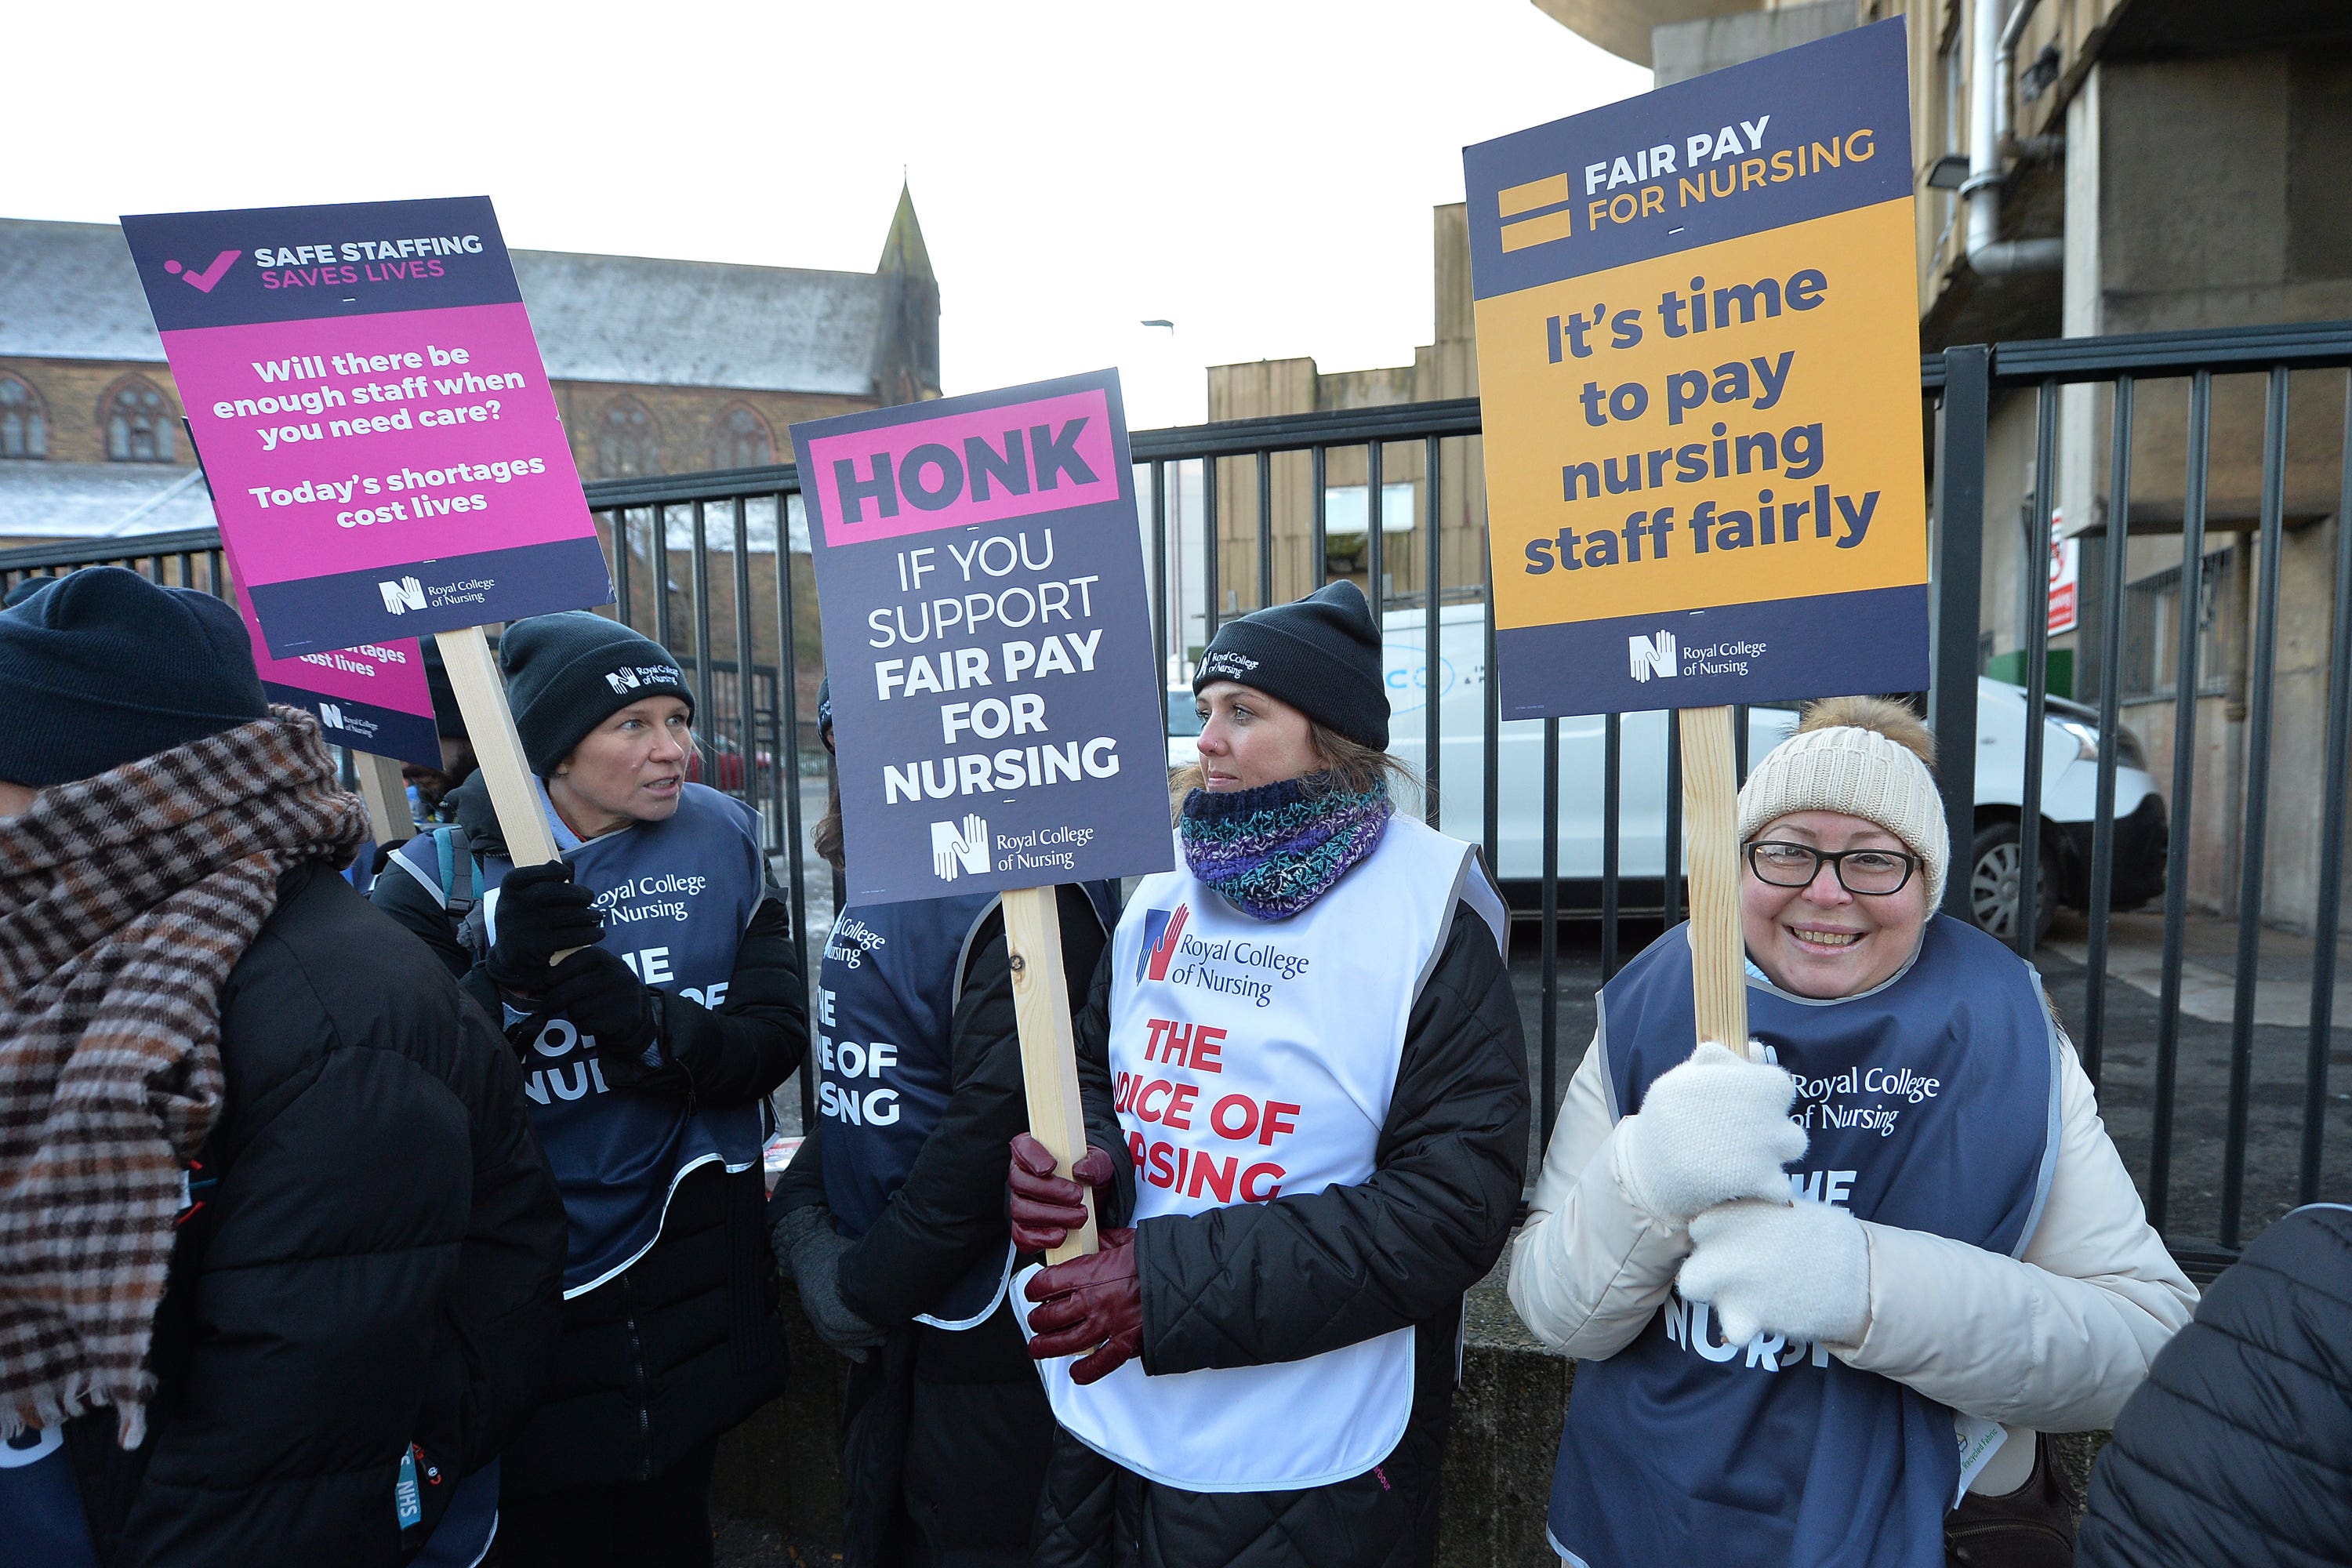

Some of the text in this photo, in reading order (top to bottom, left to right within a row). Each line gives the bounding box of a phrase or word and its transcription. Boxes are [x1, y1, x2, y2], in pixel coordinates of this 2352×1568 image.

[1584, 114, 1771, 196] FAIR PAY
[1588, 129, 1875, 231] FOR NURSING
[254, 234, 483, 268] SAFE STAFFING
[261, 259, 445, 289] SAVES LIVES
[1547, 267, 1828, 364] It's time
[252, 345, 470, 383] Will there be
[213, 368, 525, 422] enough staff when
[1580, 350, 1795, 427] to pay
[256, 400, 501, 452] you need care?
[833, 416, 1101, 524] HONK
[1562, 421, 1824, 502] nursing
[249, 454, 545, 509] Today's shortages
[336, 491, 488, 528] cost lives
[1525, 484, 1882, 575] staff fairly
[896, 528, 1054, 592] IF YOU
[428, 578, 495, 597] Royal College
[432, 592, 485, 607] of Nursing
[868, 575, 1099, 648] SUPPORT
[335, 654, 376, 677] lives
[874, 628, 1104, 701] FAIR PAY
[1213, 652, 1259, 670] Royal College
[1682, 639, 1767, 661] Royal College
[1682, 659, 1749, 677] of Nursing
[636, 665, 659, 676] Royal
[643, 676, 651, 685] of
[940, 695, 1049, 745] FOR
[883, 735, 1121, 806] NURSING
[996, 825, 1094, 853] Royal College
[997, 849, 1076, 871] of Nursing
[640, 874, 706, 896] College
[612, 900, 688, 922] Nursing
[841, 918, 886, 951] College
[1180, 934, 1310, 980] Royal College
[1172, 964, 1272, 1007] of Nursing
[837, 1041, 898, 1079] OF
[1144, 1018, 1229, 1074] THE
[1793, 1066, 1940, 1105] Royal College
[1210, 1094, 1302, 1147] OF
[1789, 1104, 1900, 1138] of Nursing
[1962, 1428, 1998, 1469] Recycled Fabric
[397, 1479, 417, 1518] NHS
